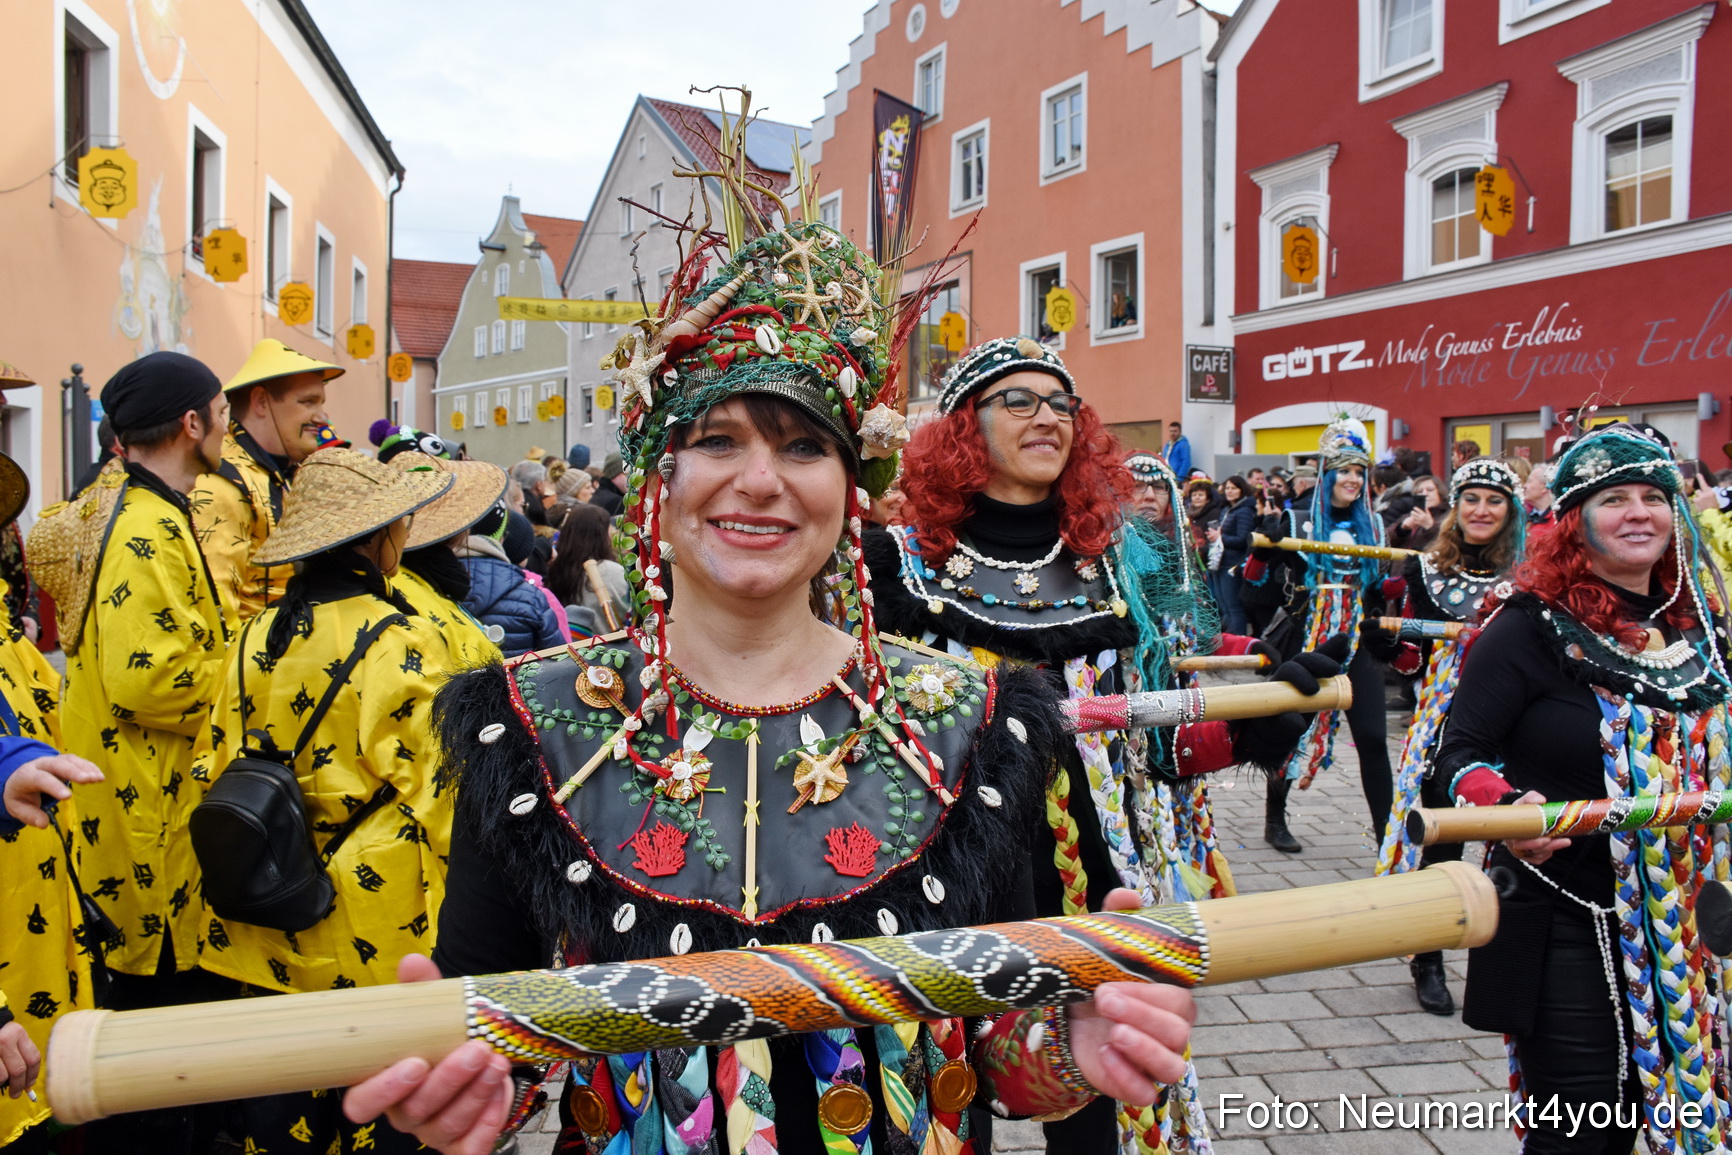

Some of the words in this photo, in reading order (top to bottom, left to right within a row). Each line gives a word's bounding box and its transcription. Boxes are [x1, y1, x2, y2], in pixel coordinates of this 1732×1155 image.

[1481, 202, 1493, 221] 人
[1378, 324, 1434, 368] Mode
[1435, 332, 1495, 371] Genuss
[1502, 302, 1582, 351] Erlebnis
[1192, 353, 1228, 373] CAFÉ
[1404, 323, 1500, 392] Mode
[1507, 344, 1618, 400] Genuss
